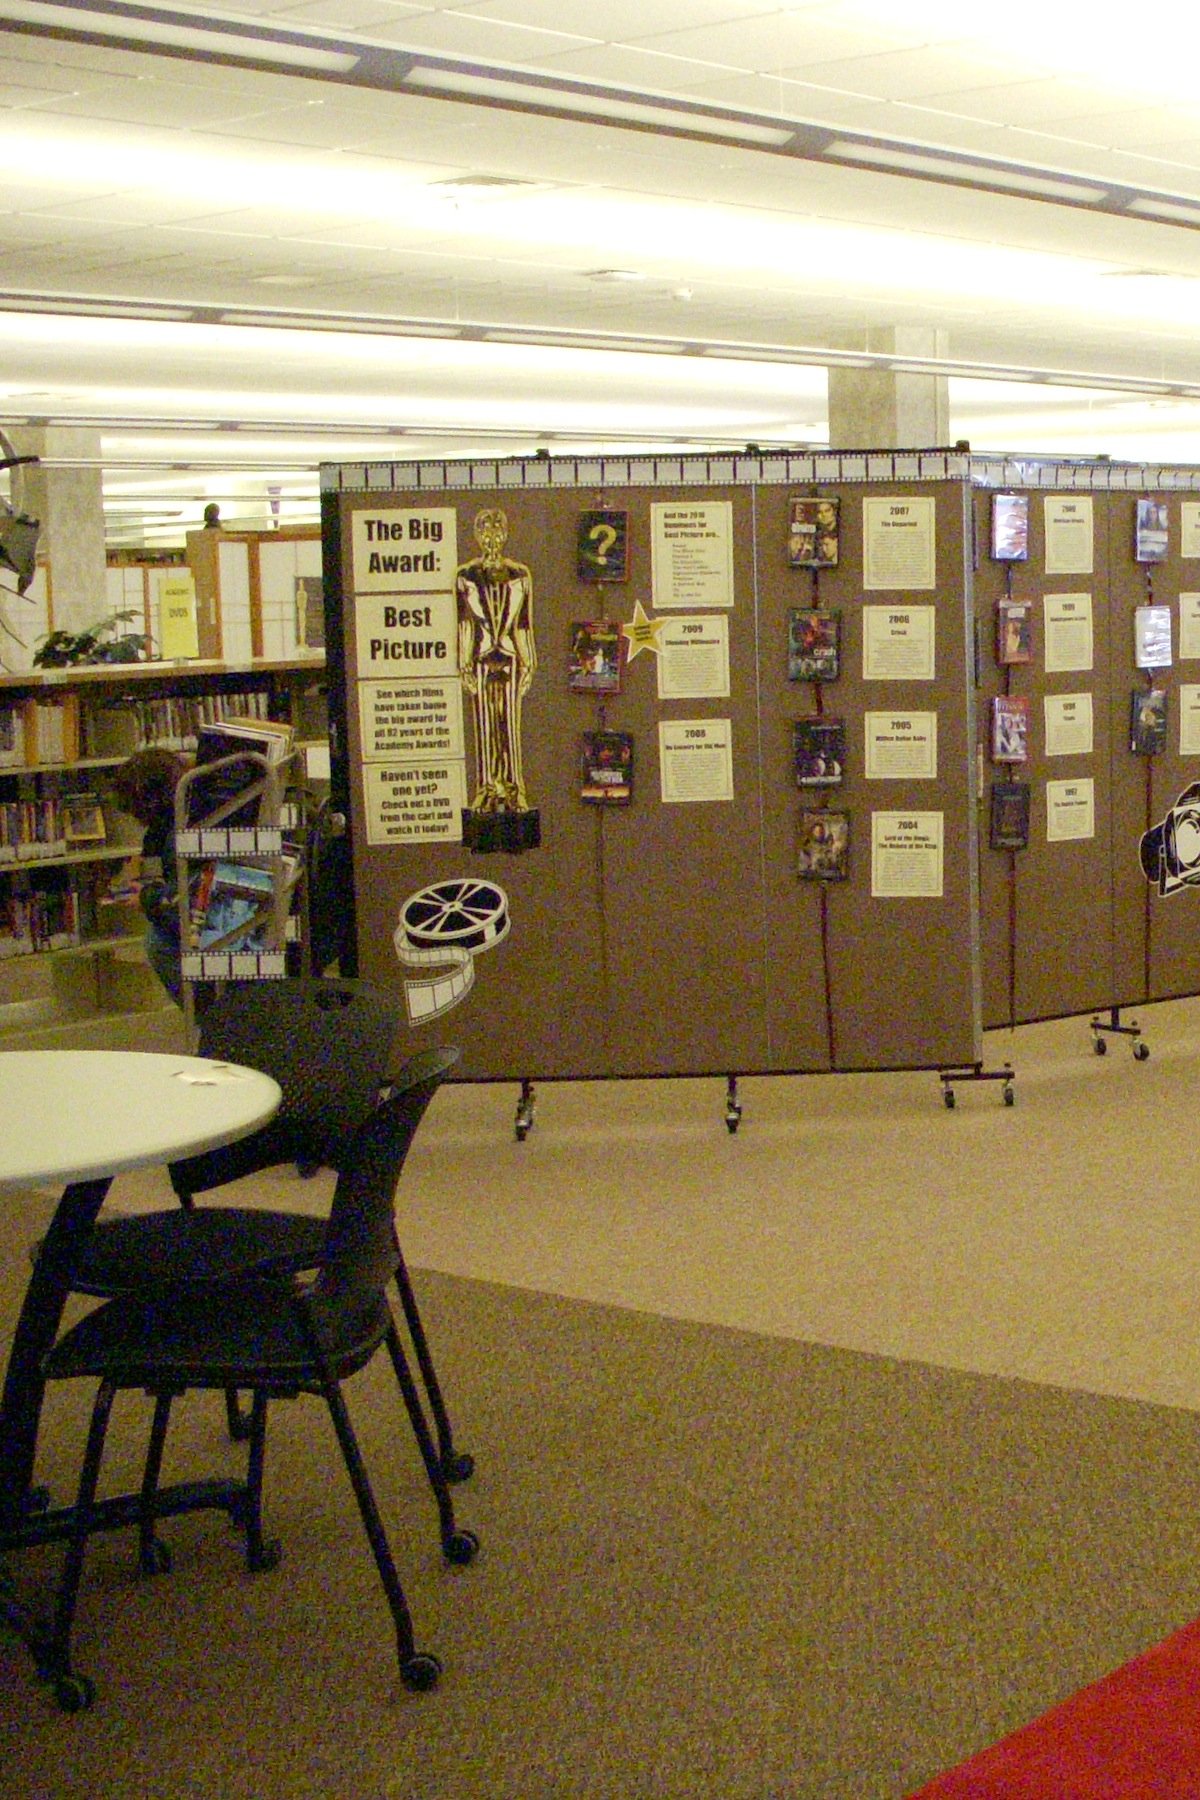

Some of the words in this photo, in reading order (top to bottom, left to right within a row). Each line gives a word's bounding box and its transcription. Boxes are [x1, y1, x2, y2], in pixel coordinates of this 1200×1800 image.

[364, 519, 403, 541] The
[408, 518, 443, 542] Big
[368, 550, 441, 574] Award:
[384, 606, 432, 628] Best
[681, 624, 704, 634] 2009
[370, 639, 447, 660] Picture
[376, 689, 393, 699] See
[394, 688, 420, 698] which
[374, 703, 395, 712] have
[397, 703, 421, 711] taken
[422, 701, 447, 710] home
[375, 716, 389, 725] the
[391, 715, 405, 725] big
[406, 714, 433, 724] award
[434, 713, 447, 723] for
[399, 728, 424, 738] years
[424, 726, 434, 736] of
[435, 726, 450, 736] the
[374, 741, 414, 751] Academy
[415, 739, 451, 749] Awards!
[380, 769, 420, 783] Haven't
[421, 769, 449, 780] seen
[391, 785, 413, 797] one
[414, 782, 439, 796] yet?
[381, 800, 409, 811] Check
[380, 813, 401, 823] from
[401, 812, 417, 822] the
[417, 811, 436, 821] cart
[436, 810, 454, 820] and
[386, 825, 414, 836] watch
